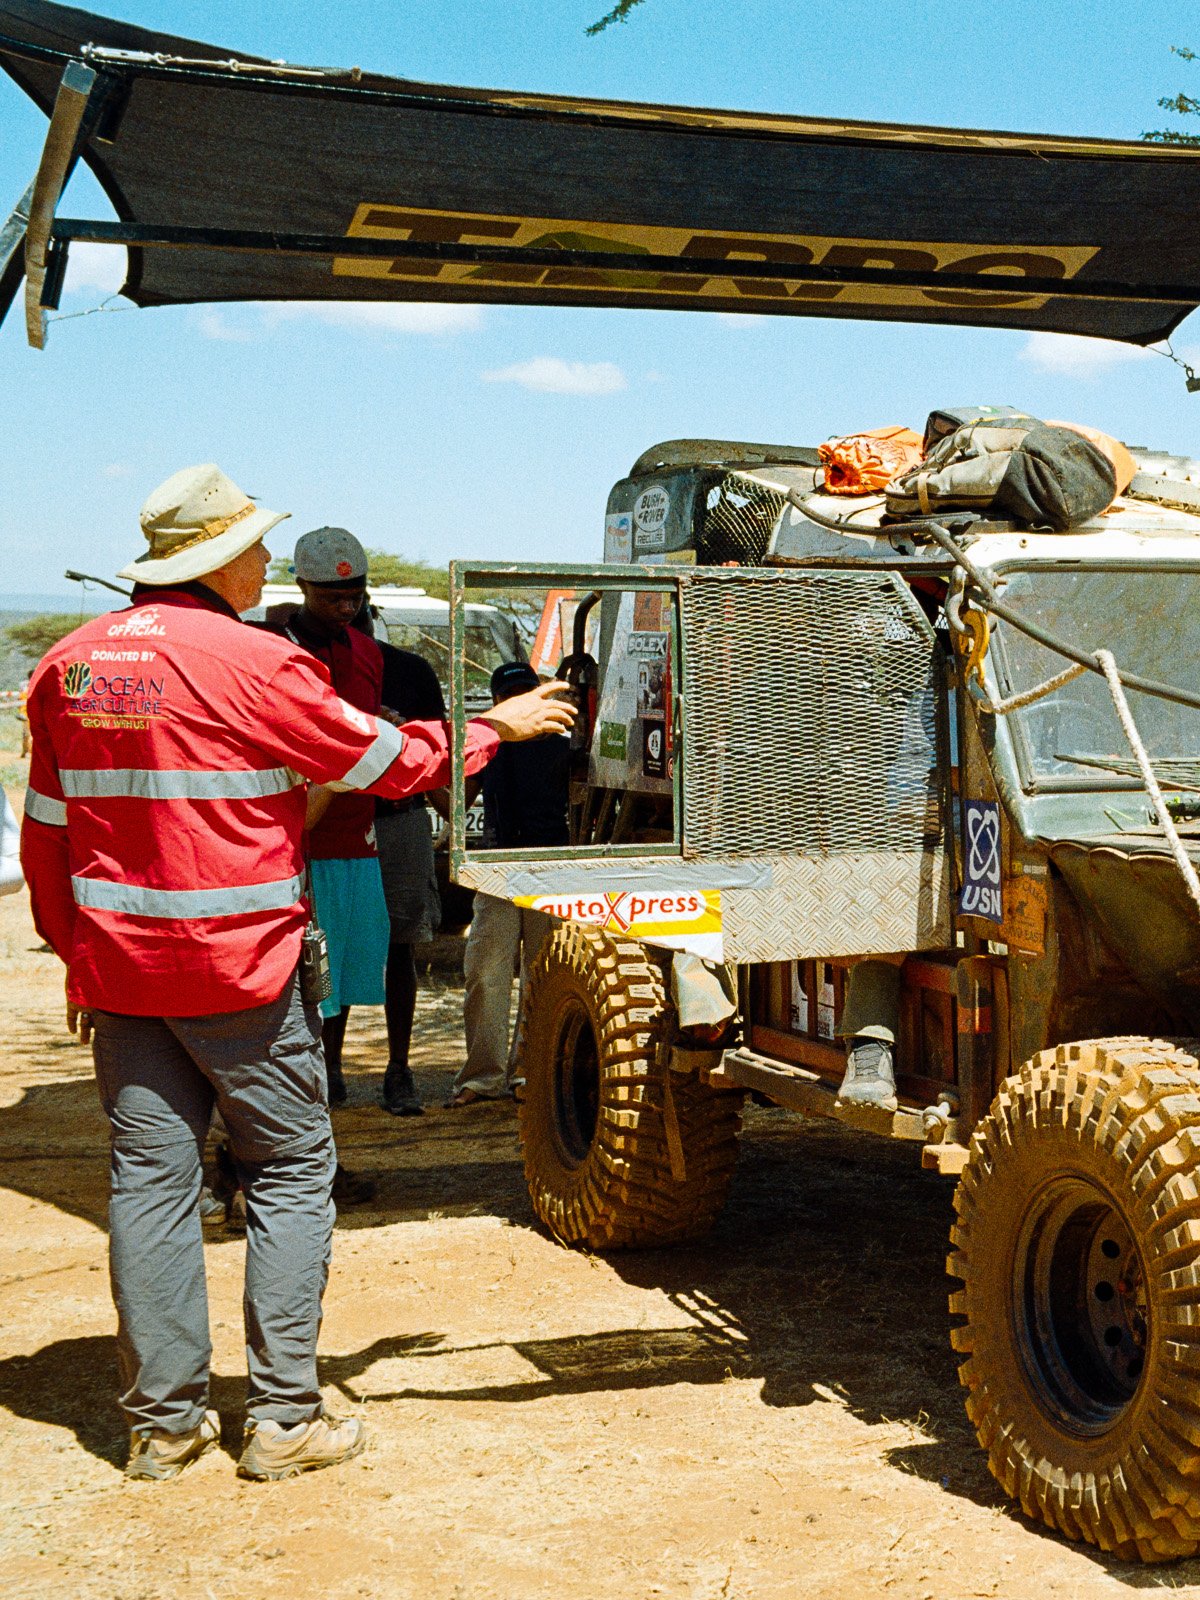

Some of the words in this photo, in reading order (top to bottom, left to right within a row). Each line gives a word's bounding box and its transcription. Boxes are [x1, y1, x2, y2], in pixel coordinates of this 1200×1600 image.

[107, 624, 167, 636] OFFICIAL
[628, 637, 666, 655] SOLEX
[91, 650, 140, 662] DONATED
[141, 651, 157, 662] BY
[92, 675, 165, 696] OCEAN
[70, 698, 162, 714] AGRICULTURE
[81, 718, 111, 728] GROW
[961, 885, 1002, 916] USN
